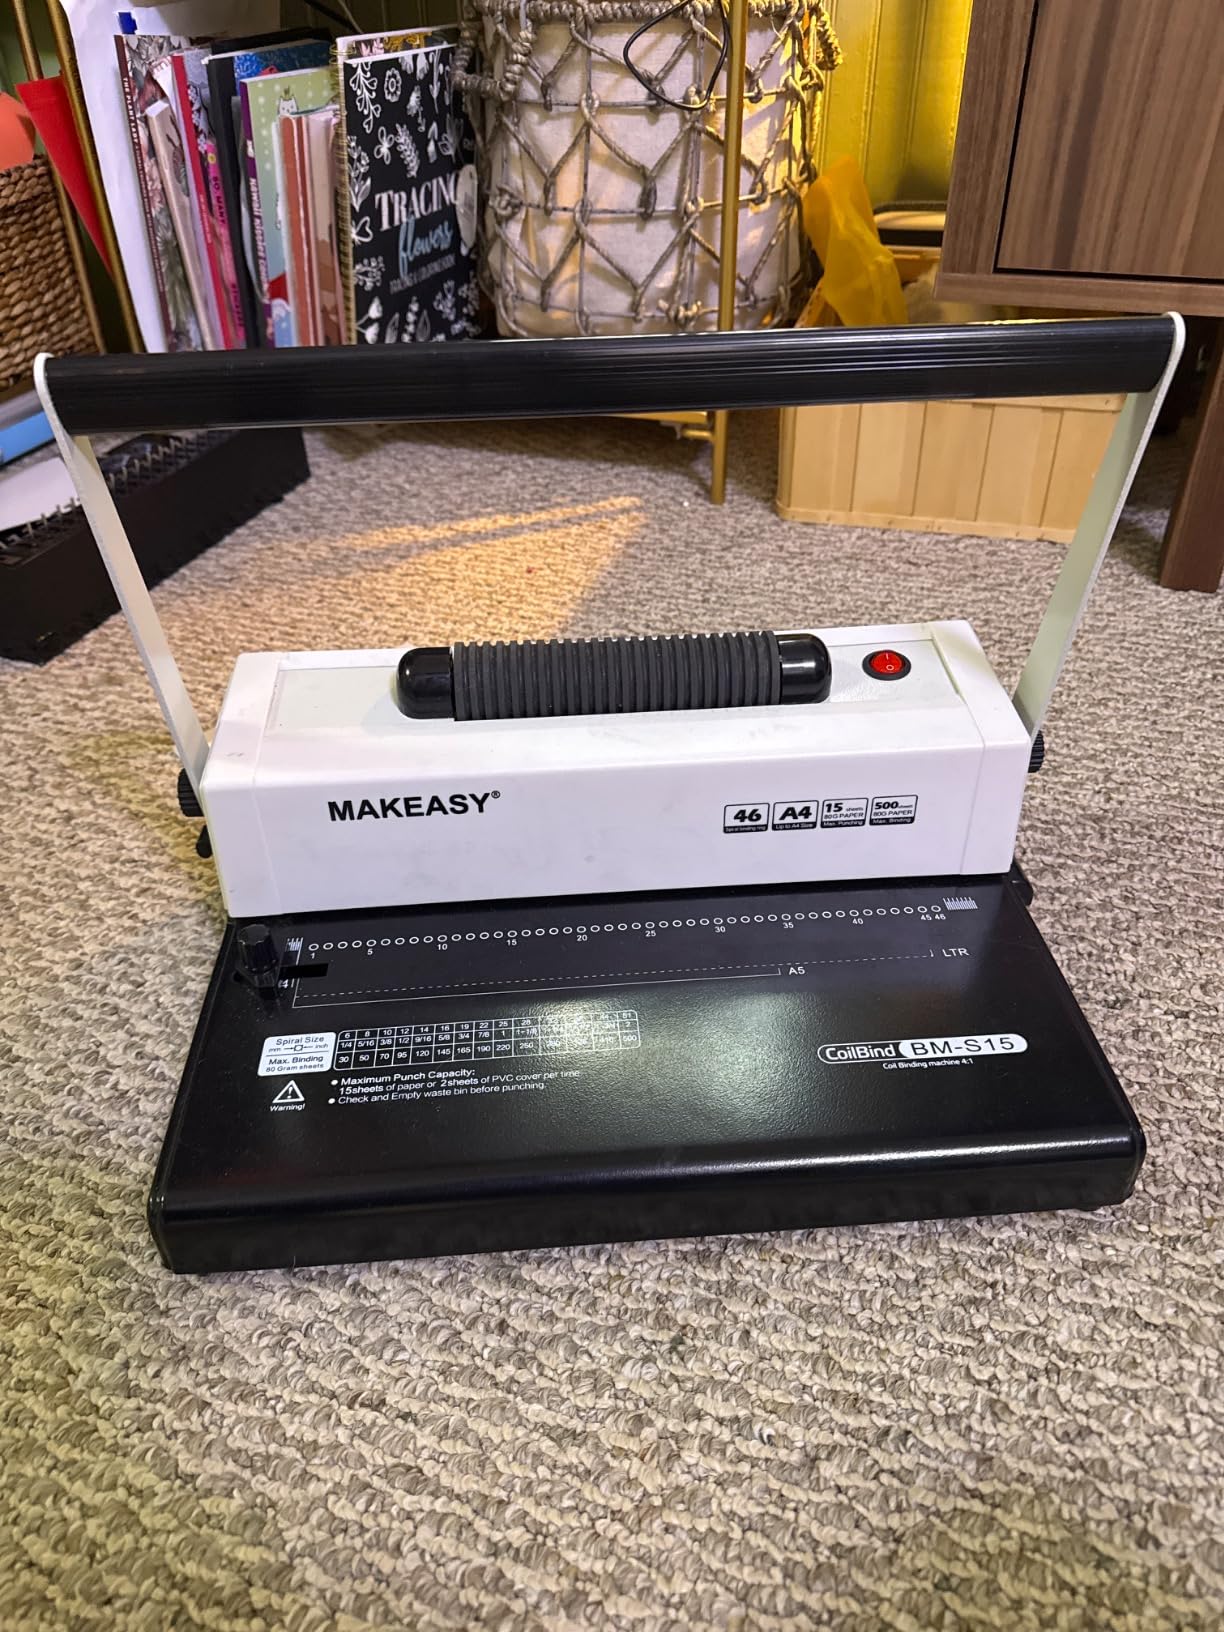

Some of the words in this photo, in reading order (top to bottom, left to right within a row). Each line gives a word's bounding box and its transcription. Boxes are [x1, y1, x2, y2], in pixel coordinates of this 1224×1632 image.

[123, 77, 131, 92] THE
[126, 95, 135, 120] PLANT
[130, 122, 138, 143] LADY
[825, 802, 844, 813] 15
[874, 801, 899, 810] 500
[733, 808, 762, 822] 46
[779, 805, 812, 821] A4
[367, 948, 374, 956] 5
[437, 943, 448, 951] 10
[714, 925, 726, 933] 30
[941, 948, 970, 958] LTR
[788, 966, 806, 976] A5
[276, 1037, 303, 1046] Spiral
[380, 1038, 392, 1046] 3/8
[414, 1035, 431, 1043] 9/16
[825, 1044, 896, 1061] CoilBind
[910, 1037, 1014, 1056] BM-S15
[292, 1056, 324, 1064] Binding
[882, 1062, 897, 1070] Coil
[898, 1060, 928, 1069] Binding
[341, 1076, 391, 1086] Maximum
[393, 1072, 426, 1081] Punch
[427, 1068, 476, 1079] Capacity:
[385, 1083, 395, 1091] of
[397, 1082, 425, 1091] paper
[440, 1077, 479, 1087] 2sheets
[480, 1075, 490, 1084] of
[491, 1074, 514, 1083] PVC
[515, 1073, 542, 1081] cover
[543, 1071, 559, 1080] per
[337, 1096, 369, 1105] Check
[370, 1093, 389, 1102] and
[391, 1091, 422, 1101] Empty
[423, 1089, 452, 1098] waste
[453, 1086, 468, 1095] bin
[470, 1084, 500, 1094] before
[270, 1103, 306, 1112] Warning!
